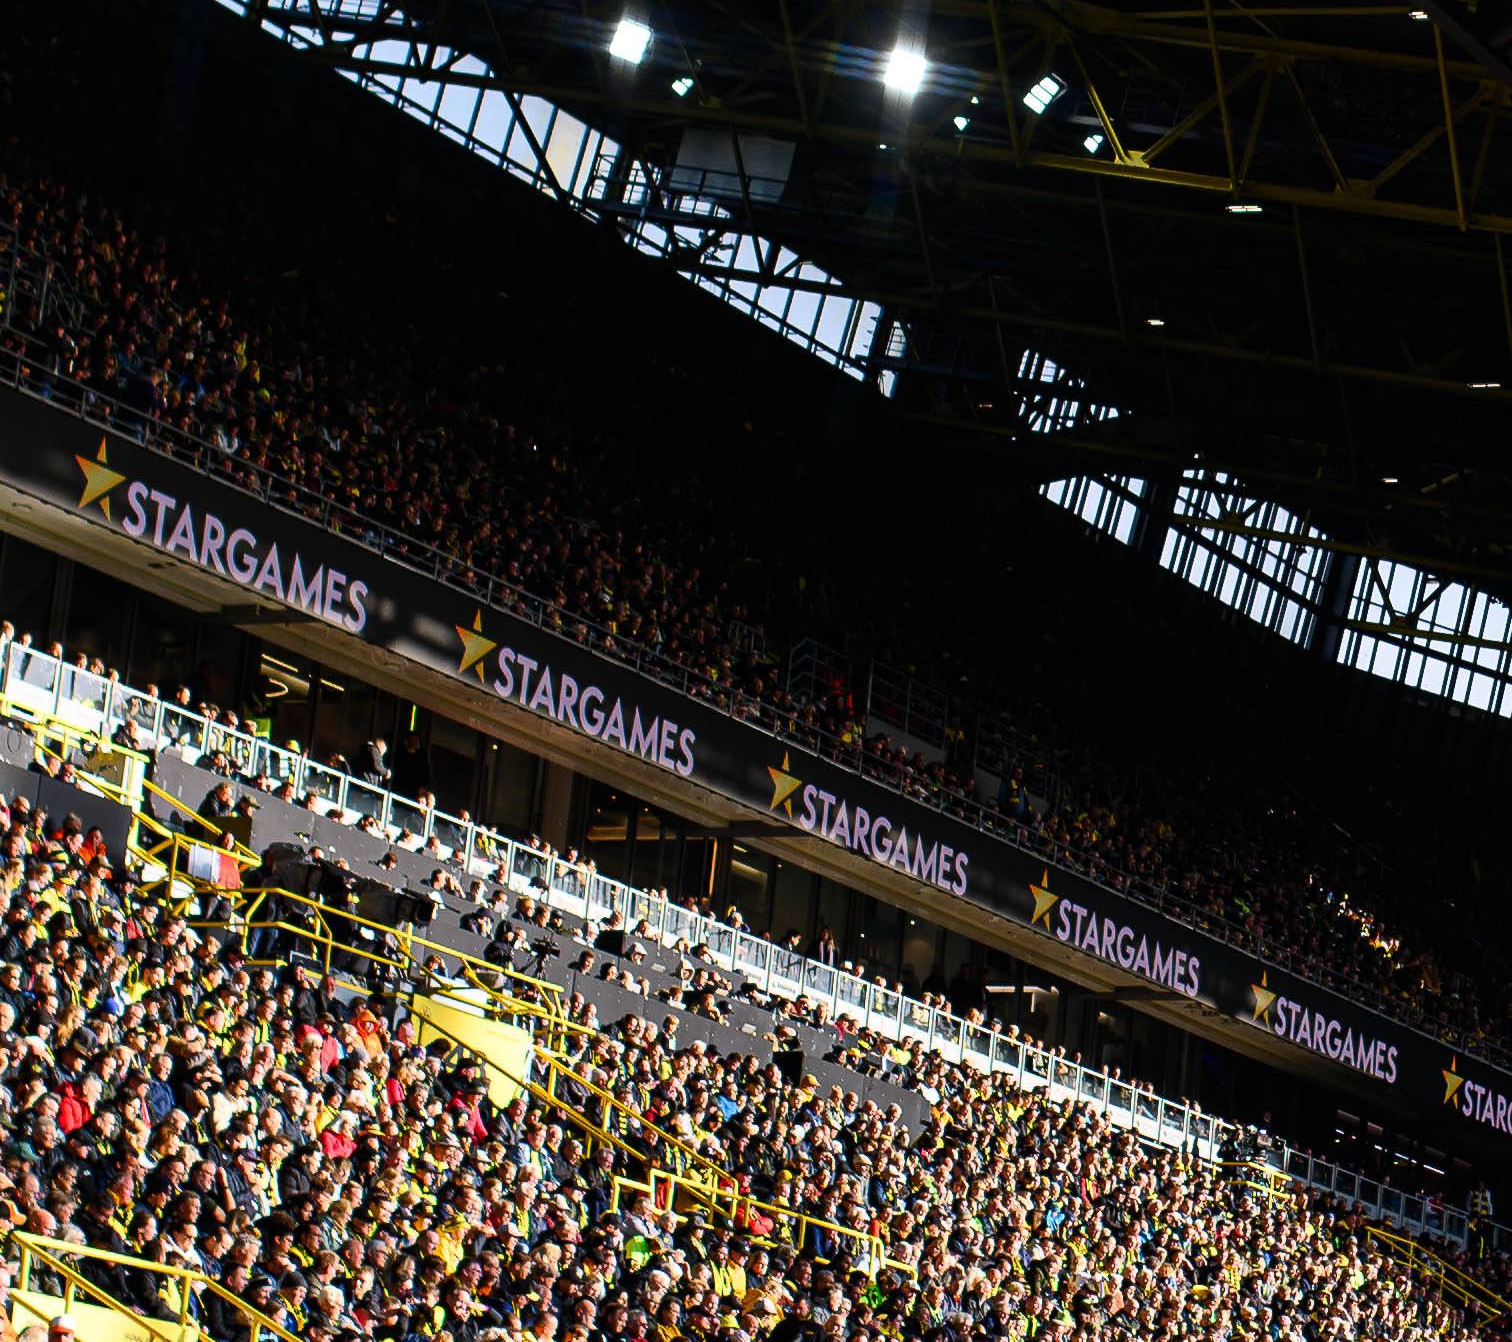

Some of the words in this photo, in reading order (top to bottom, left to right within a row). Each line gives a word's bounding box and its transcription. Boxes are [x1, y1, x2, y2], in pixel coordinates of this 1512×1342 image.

[122, 480, 368, 635] STARGAMES
[494, 647, 696, 777] STARGAMES
[800, 784, 969, 897] STARGAMES
[1055, 899, 1200, 997] STARGAMES
[1274, 996, 1398, 1084] STARGAMES
